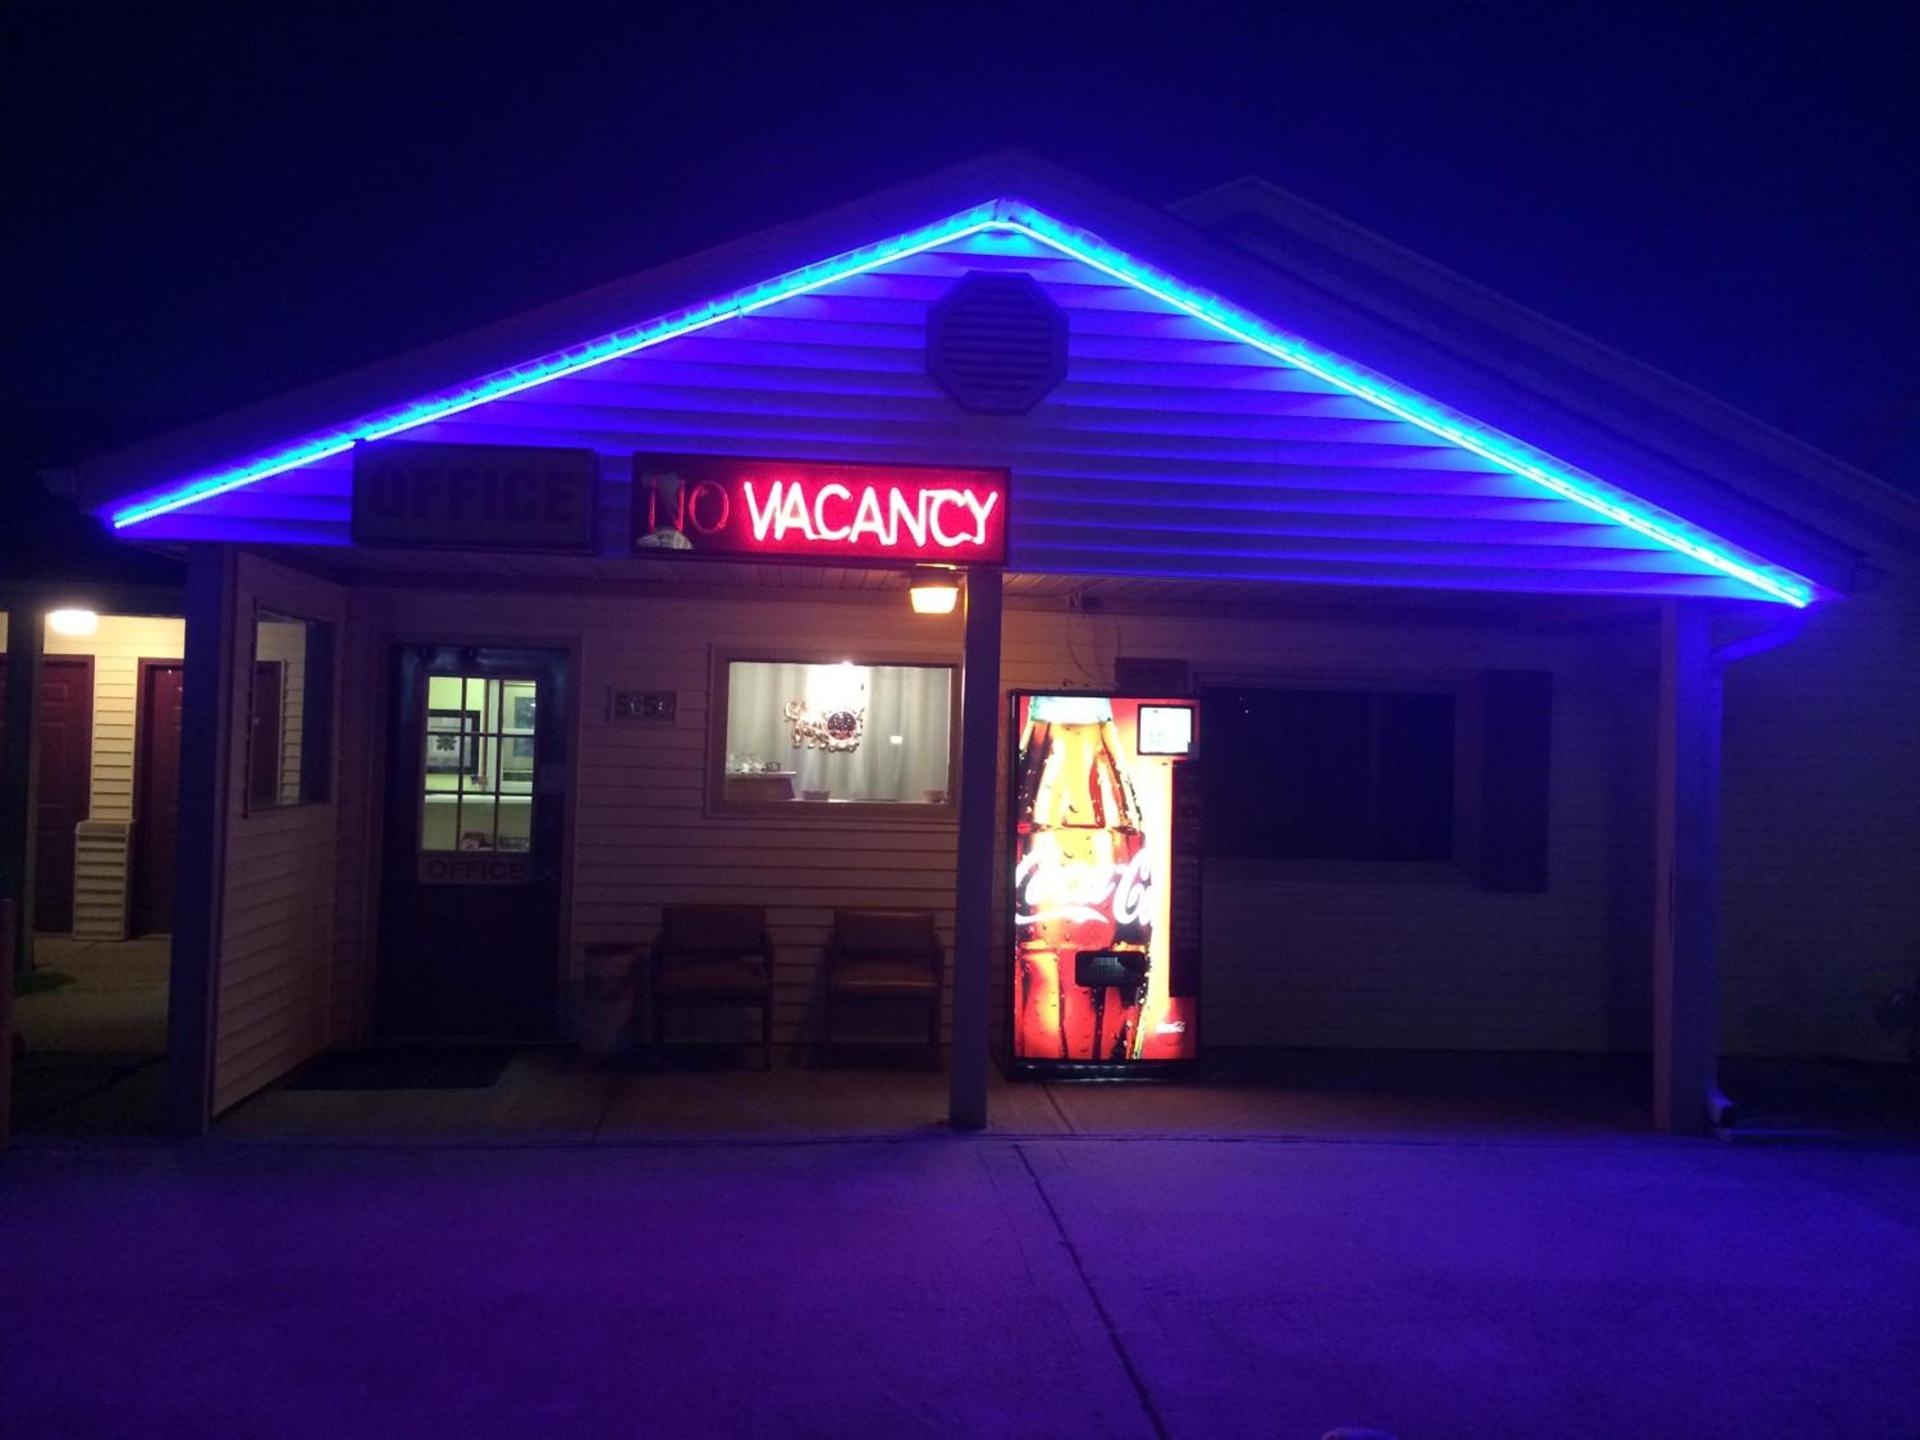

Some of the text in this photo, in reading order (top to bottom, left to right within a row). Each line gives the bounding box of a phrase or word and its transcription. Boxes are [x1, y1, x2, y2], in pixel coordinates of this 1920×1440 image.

[372, 463, 577, 522] OFFICE
[651, 478, 998, 548] NO VACANCY
[427, 860, 526, 880] OFFICE
